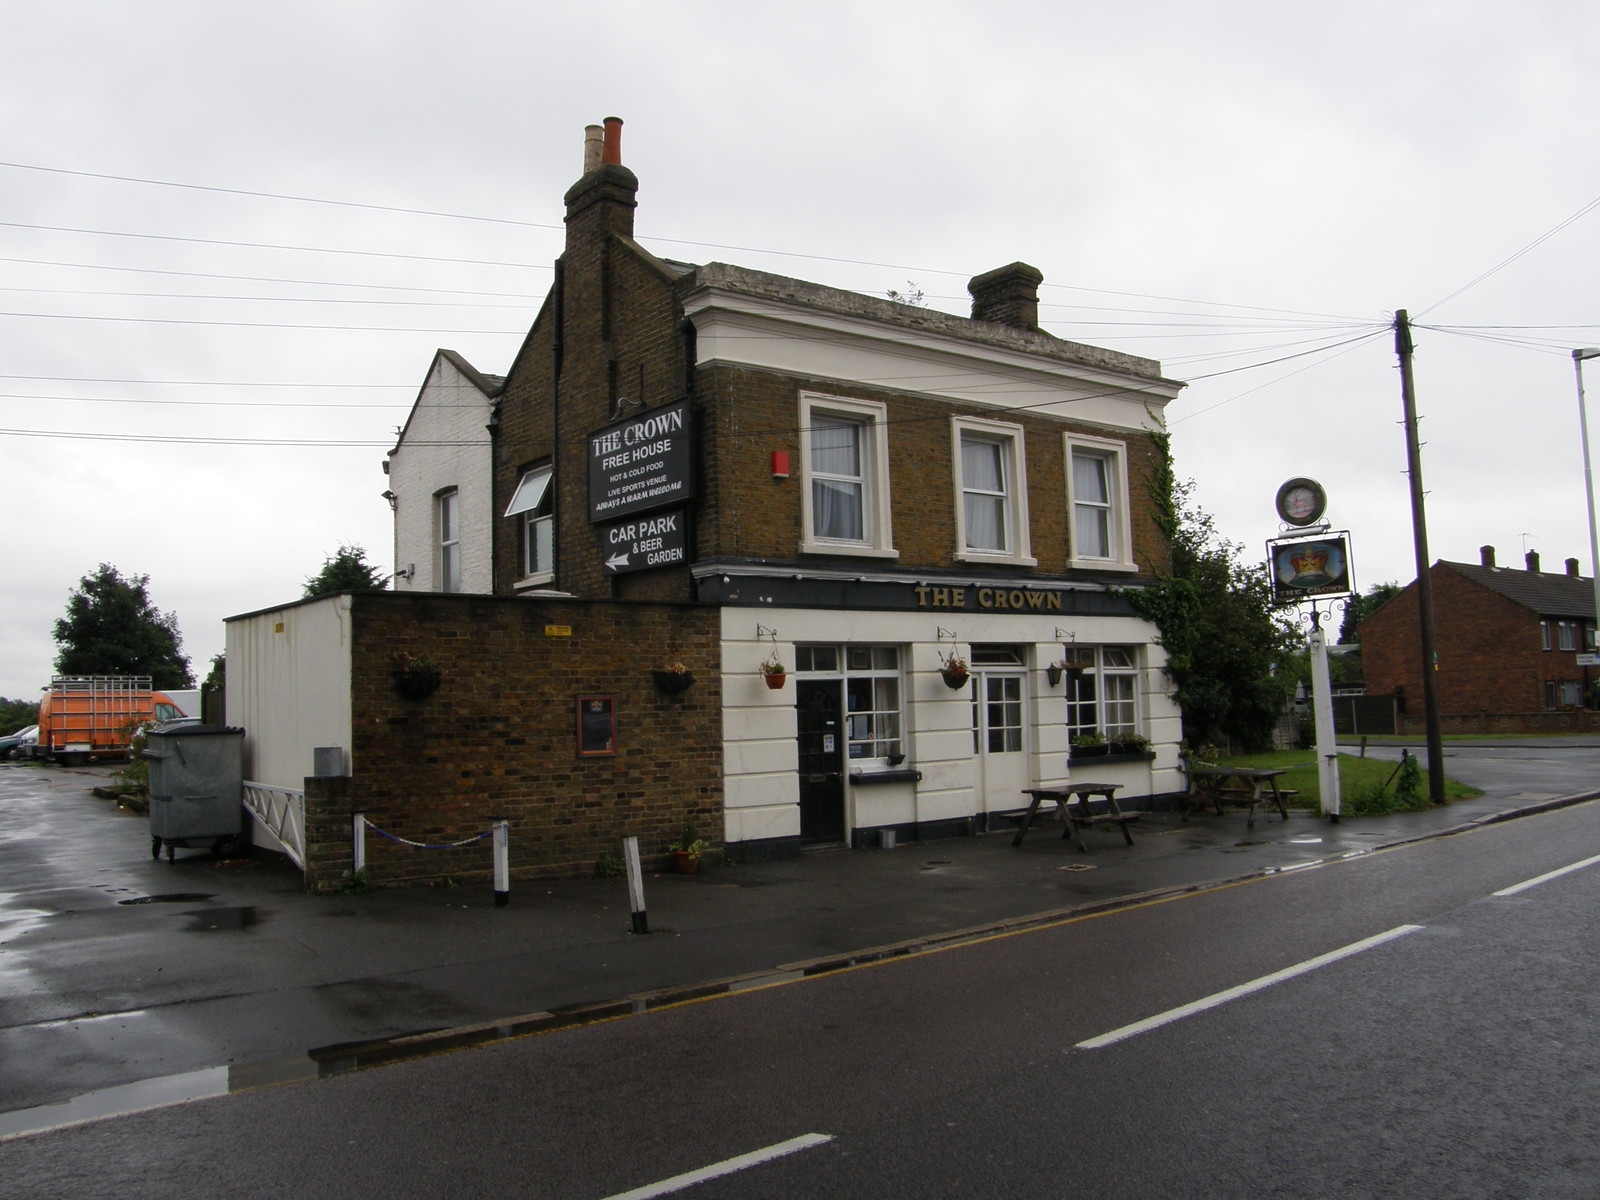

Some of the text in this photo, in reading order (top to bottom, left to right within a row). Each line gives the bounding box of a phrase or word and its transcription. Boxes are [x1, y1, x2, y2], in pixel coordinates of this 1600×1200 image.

[593, 409, 682, 457] THE CROWN
[603, 439, 671, 470] FREE HOUSE
[610, 473, 622, 483] HOT
[629, 467, 645, 477] COLD
[646, 461, 663, 472] FOOD
[596, 481, 682, 511] ALWAYS A WARM WELCOME
[608, 475, 667, 497] LIVE SPORTS VENUE
[610, 515, 676, 544] CAR PARK
[633, 537, 662, 554] & BEER
[647, 547, 682, 565] GARDEN
[915, 586, 1062, 609] THE CROWN
[1279, 585, 1345, 597] THE CROWN
